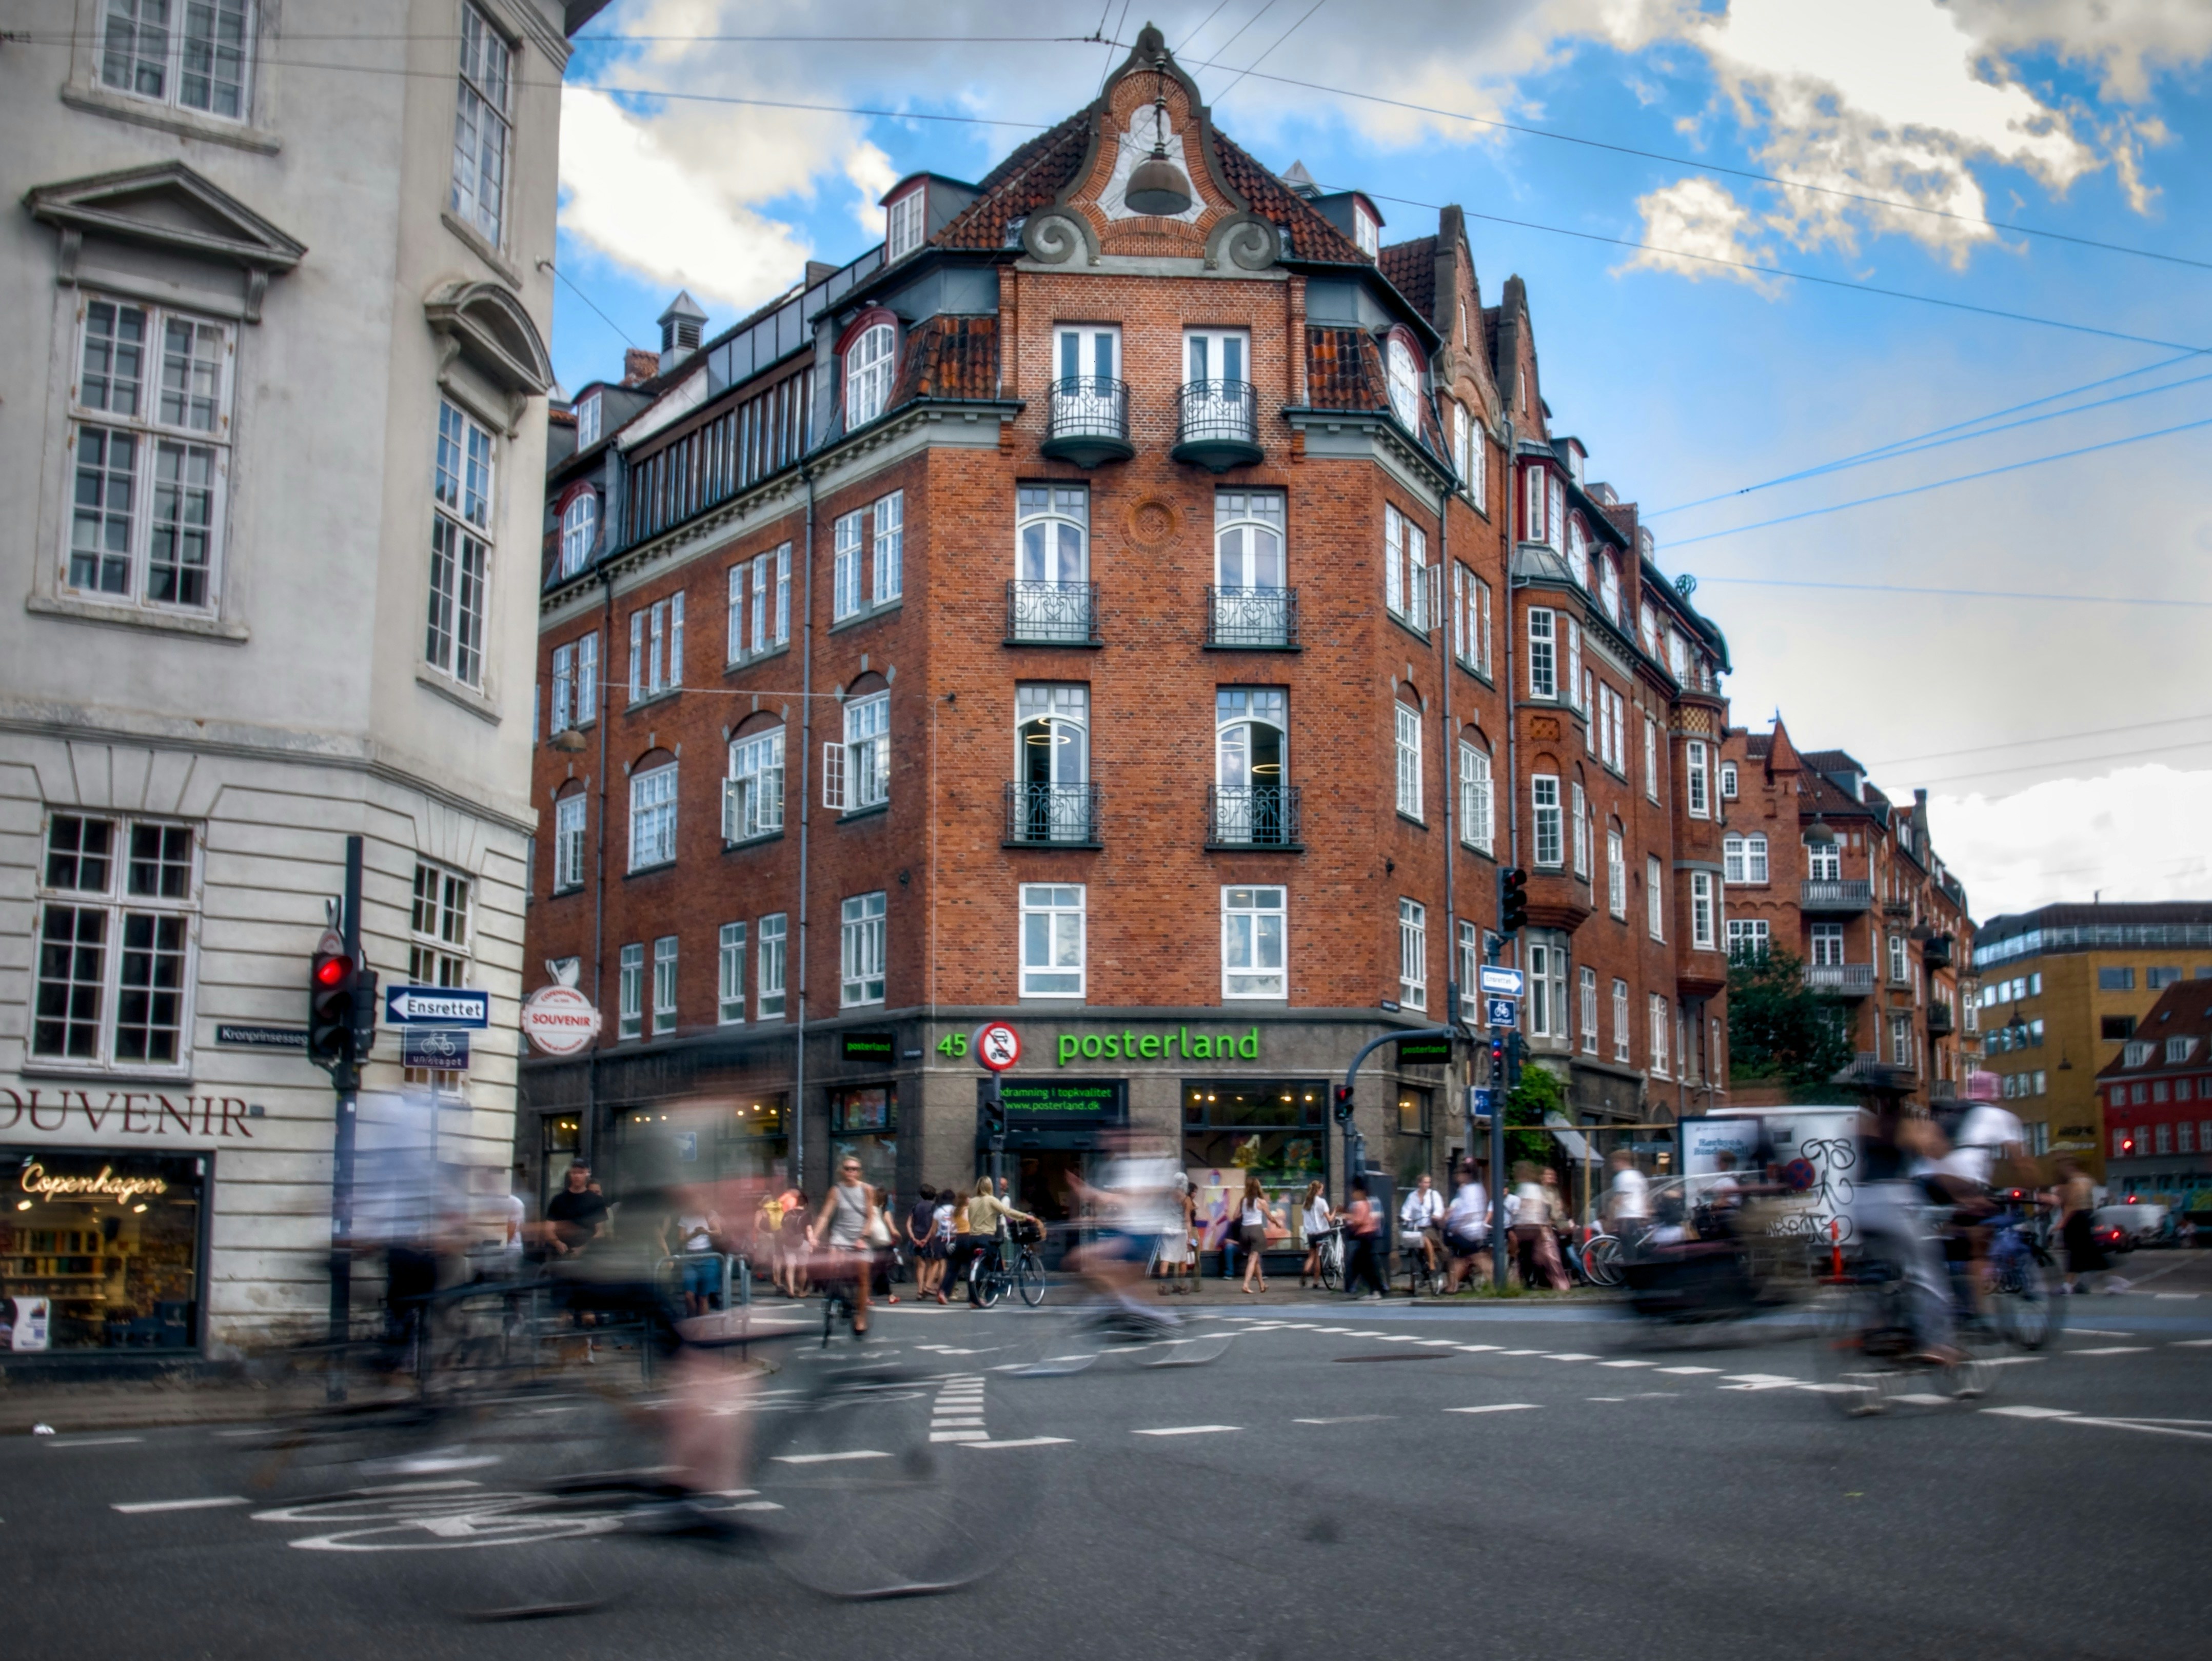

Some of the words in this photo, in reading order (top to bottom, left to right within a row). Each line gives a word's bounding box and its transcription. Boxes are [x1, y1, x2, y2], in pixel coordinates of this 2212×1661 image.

[408, 999, 480, 1016] Ensrettet
[532, 1013, 590, 1026] SOUVENIR
[847, 1042, 892, 1051] posterland
[937, 1033, 967, 1057] 45
[1058, 1025, 1259, 1066] posterland
[1401, 1044, 1448, 1056] posterland
[1057, 1087, 1112, 1099] topkvalitet
[1005, 1100, 1101, 1113] www.posterland.dk
[21, 1163, 168, 1205] Copenhagen
